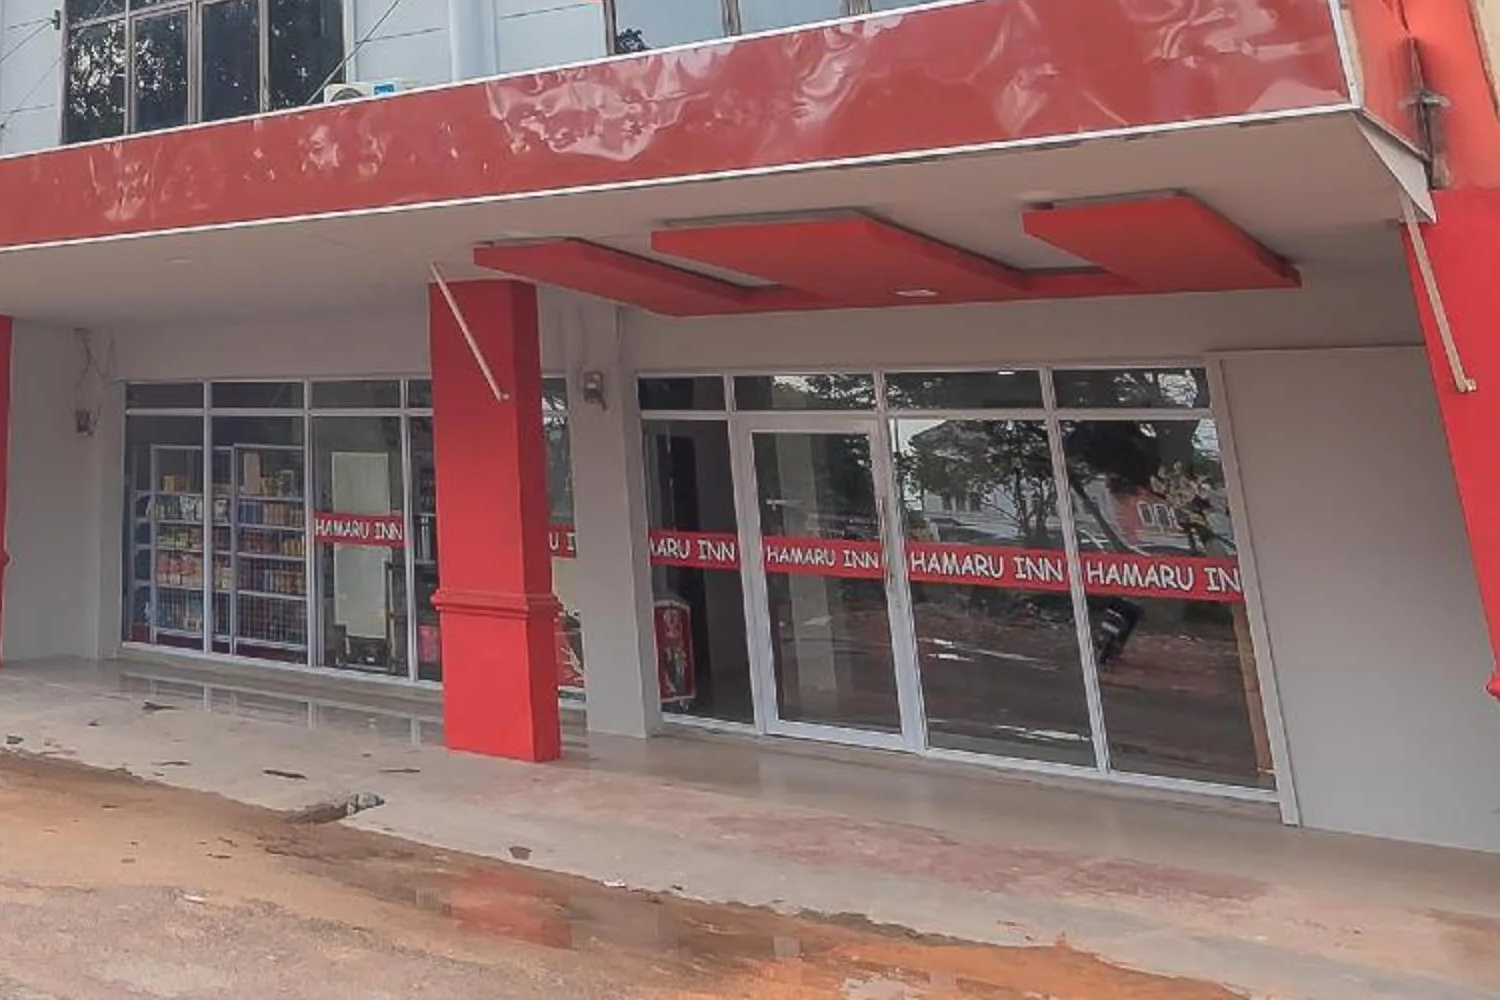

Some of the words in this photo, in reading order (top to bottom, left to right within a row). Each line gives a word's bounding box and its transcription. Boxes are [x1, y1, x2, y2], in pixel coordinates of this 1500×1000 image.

[315, 519, 369, 539] HAMARU
[374, 521, 403, 540] INN
[697, 540, 735, 562] INN
[767, 545, 837, 567] HAMARU
[843, 550, 879, 569] INN
[910, 551, 1005, 579] HAMARU
[1013, 556, 1064, 582] INN
[1086, 560, 1195, 592] HAMARU
